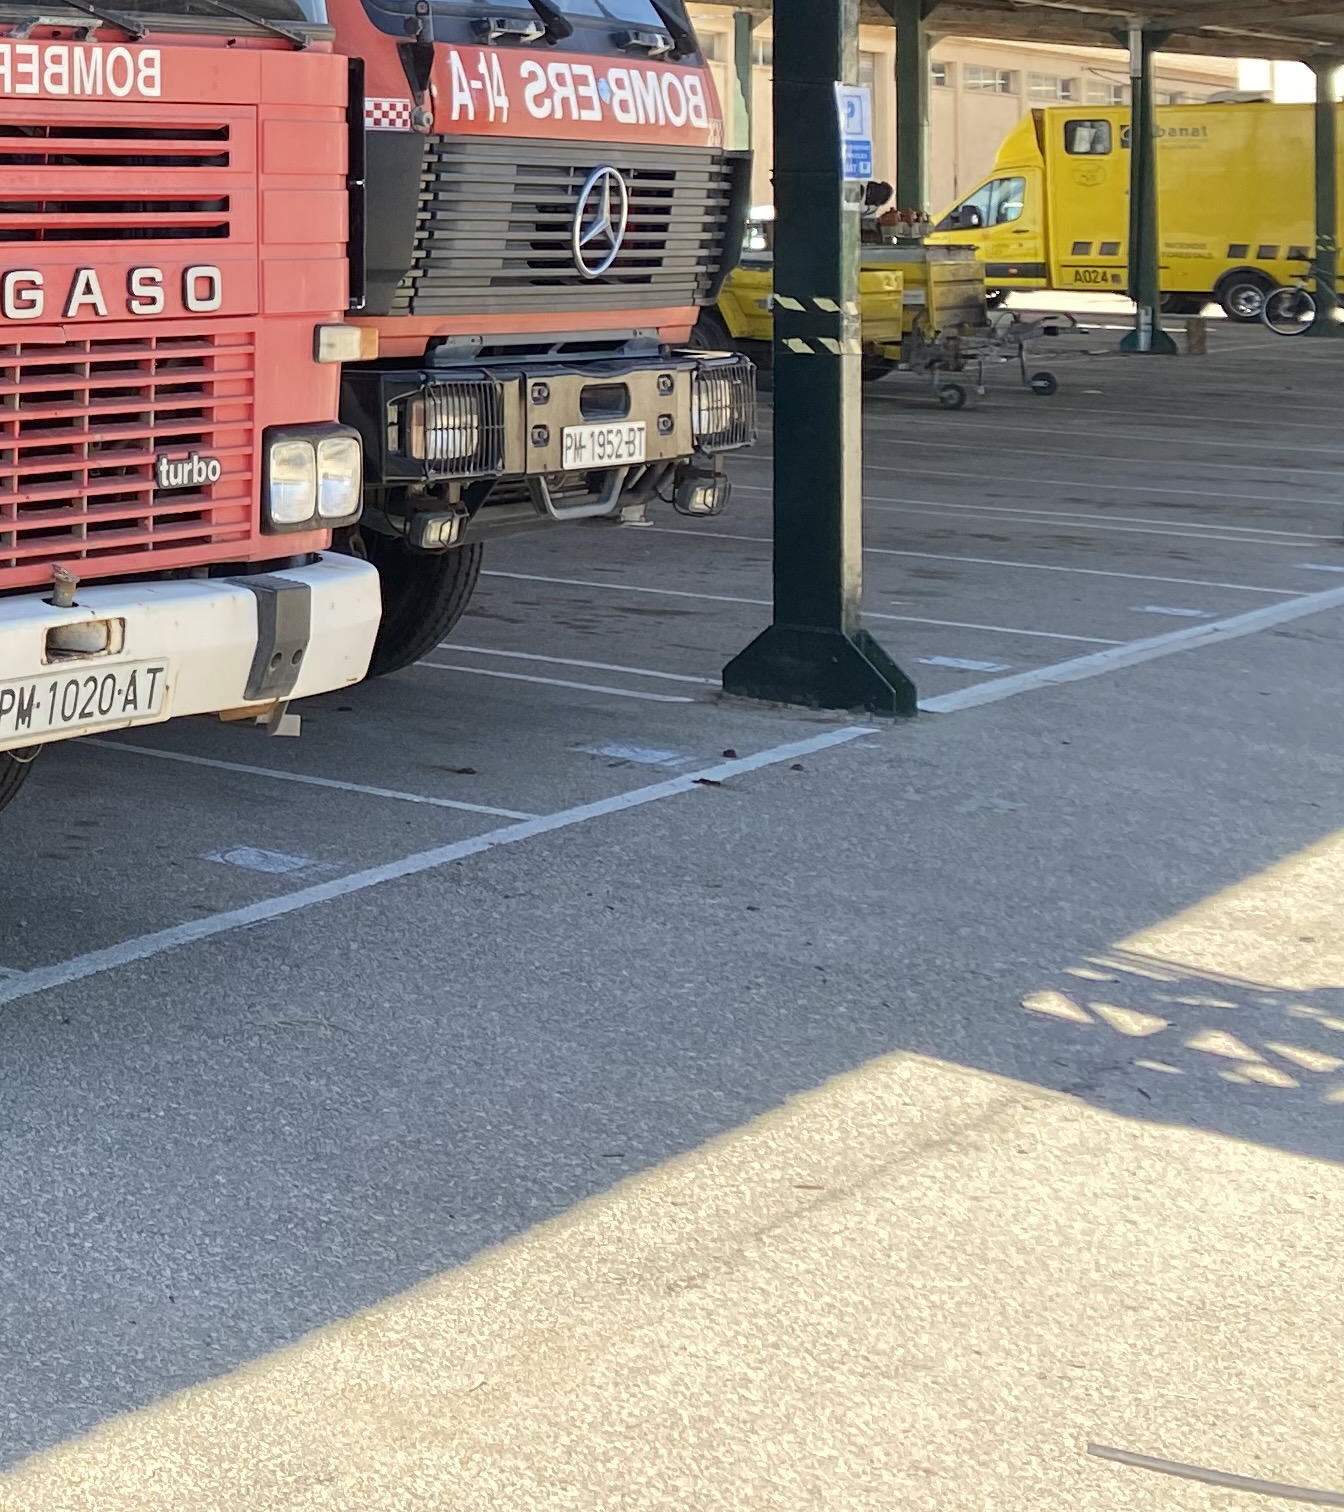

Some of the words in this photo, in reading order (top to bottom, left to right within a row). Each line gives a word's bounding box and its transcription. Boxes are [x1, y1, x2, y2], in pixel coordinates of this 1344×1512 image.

[1153, 124, 1208, 140] banat
[1073, 269, 1109, 284] A024
[159, 454, 221, 487] turbo
